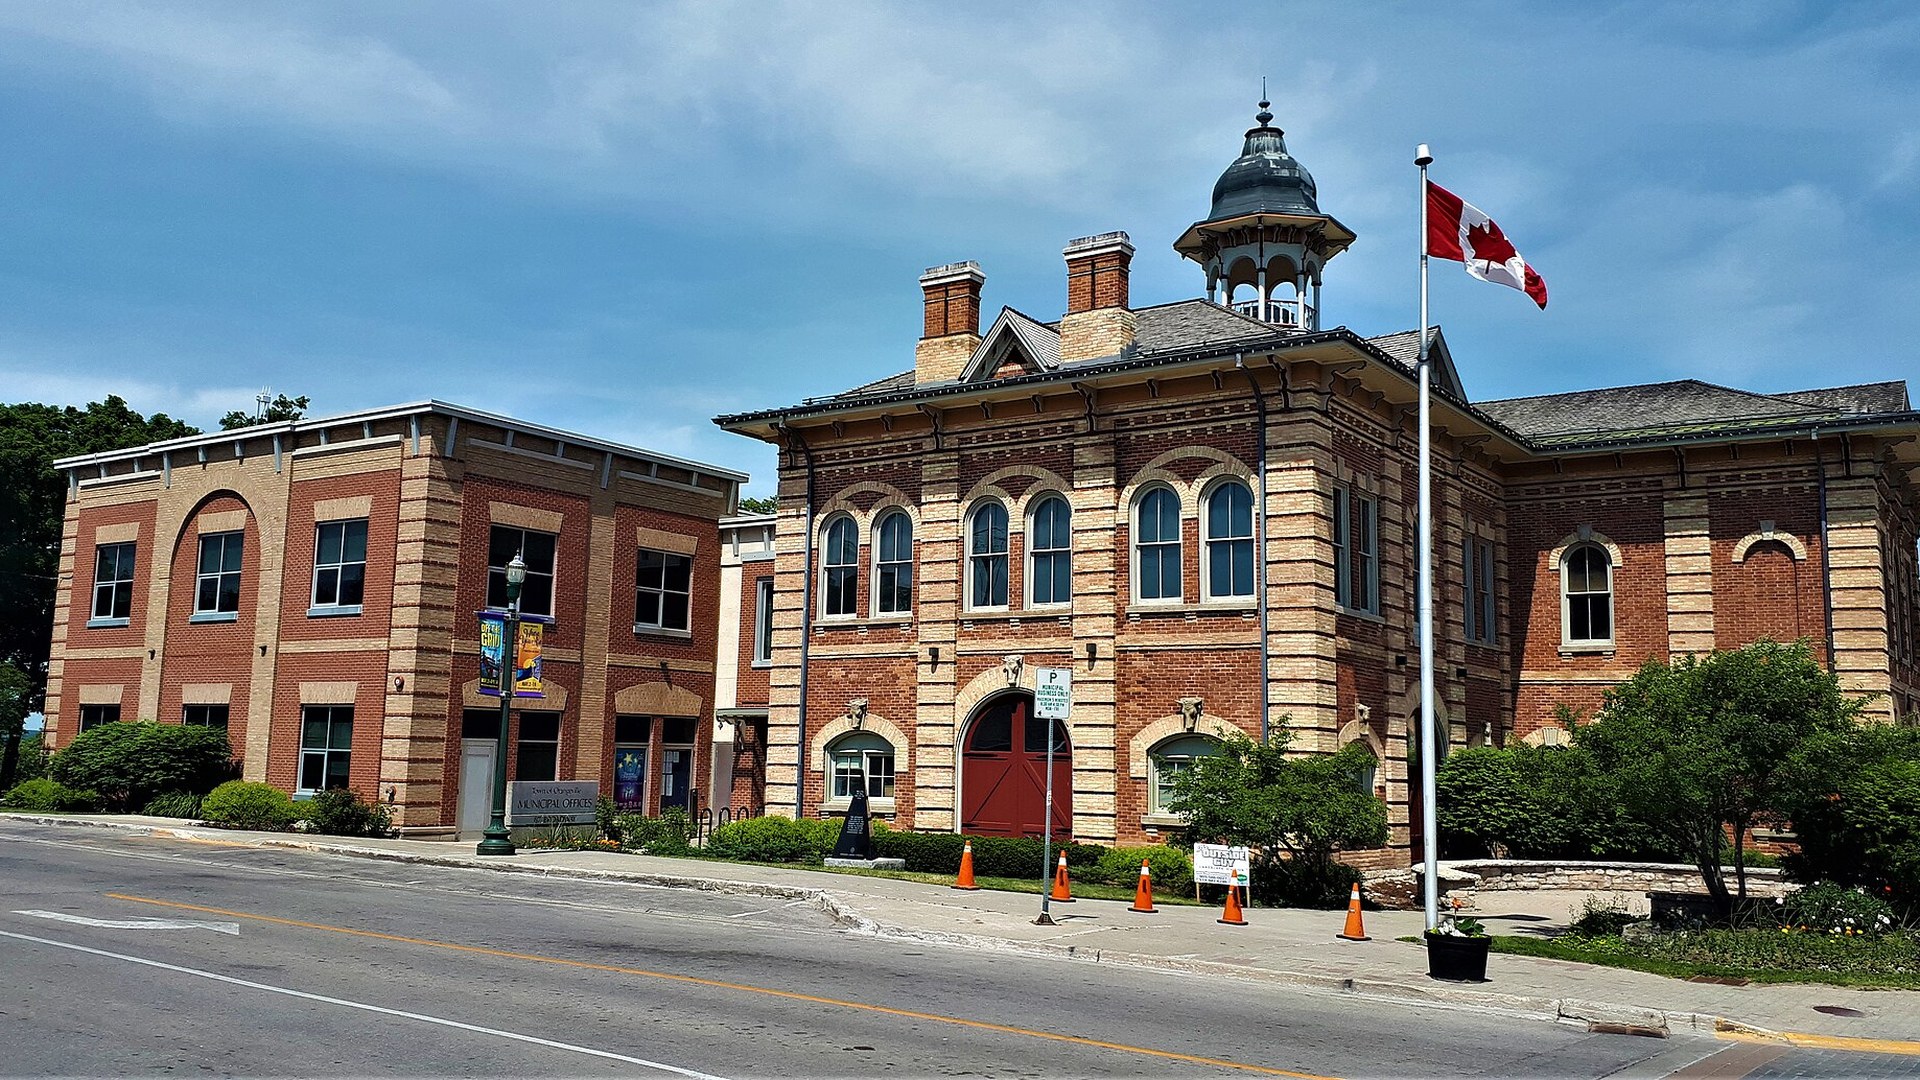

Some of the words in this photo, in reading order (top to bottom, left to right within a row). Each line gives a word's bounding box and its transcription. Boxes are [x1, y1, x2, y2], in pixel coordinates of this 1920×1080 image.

[481, 633, 500, 648] GRID
[1050, 672, 1058, 684] P
[517, 799, 560, 808] MUNICIPAL
[562, 798, 593, 808] OFFICES
[1202, 849, 1246, 861] OUTSIDE
[1213, 858, 1235, 867] GUY
